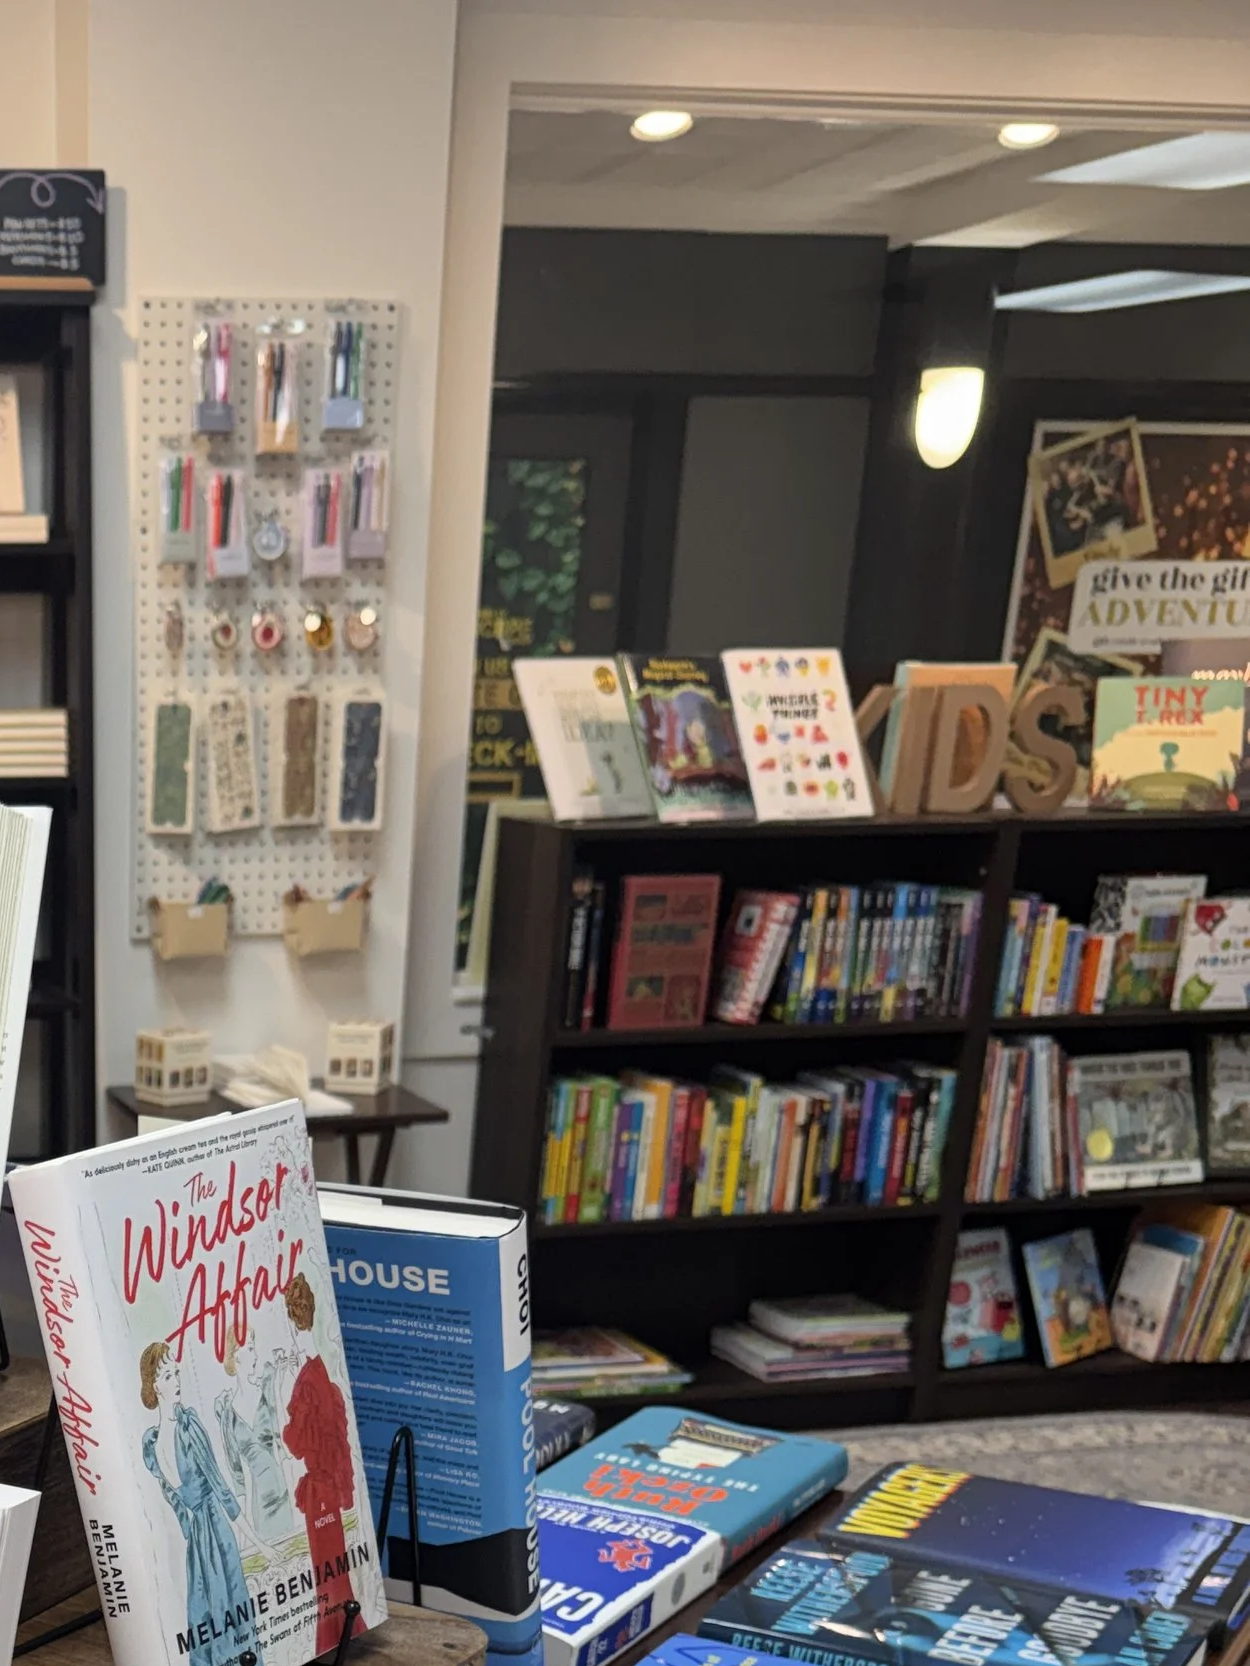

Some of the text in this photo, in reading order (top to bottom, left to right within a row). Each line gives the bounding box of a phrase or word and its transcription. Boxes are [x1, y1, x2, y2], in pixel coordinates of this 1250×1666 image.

[1090, 566, 1152, 597] give
[1159, 567, 1204, 591] the
[1135, 686, 1209, 706] TINY
[1159, 709, 1204, 725] REX
[184, 1172, 216, 1206] The
[124, 1161, 288, 1304] Windsor
[166, 1230, 303, 1363] Affair
[330, 1257, 450, 1296] HOUSE
[516, 1252, 530, 1337] CHOI
[519, 1378, 541, 1596] POOL HOUSE
[589, 1464, 729, 1503] Ozeki
[594, 1452, 759, 1493] THE TYPING LADY
[583, 1480, 703, 1516] Ruth
[592, 1516, 692, 1549] JOSEPH
[176, 1542, 370, 1655] MELANIE BENJAMIN
[900, 1570, 973, 1612] GONE
[928, 1605, 1024, 1666] BEFORE
[1018, 1597, 1122, 1663] GOODBYE
